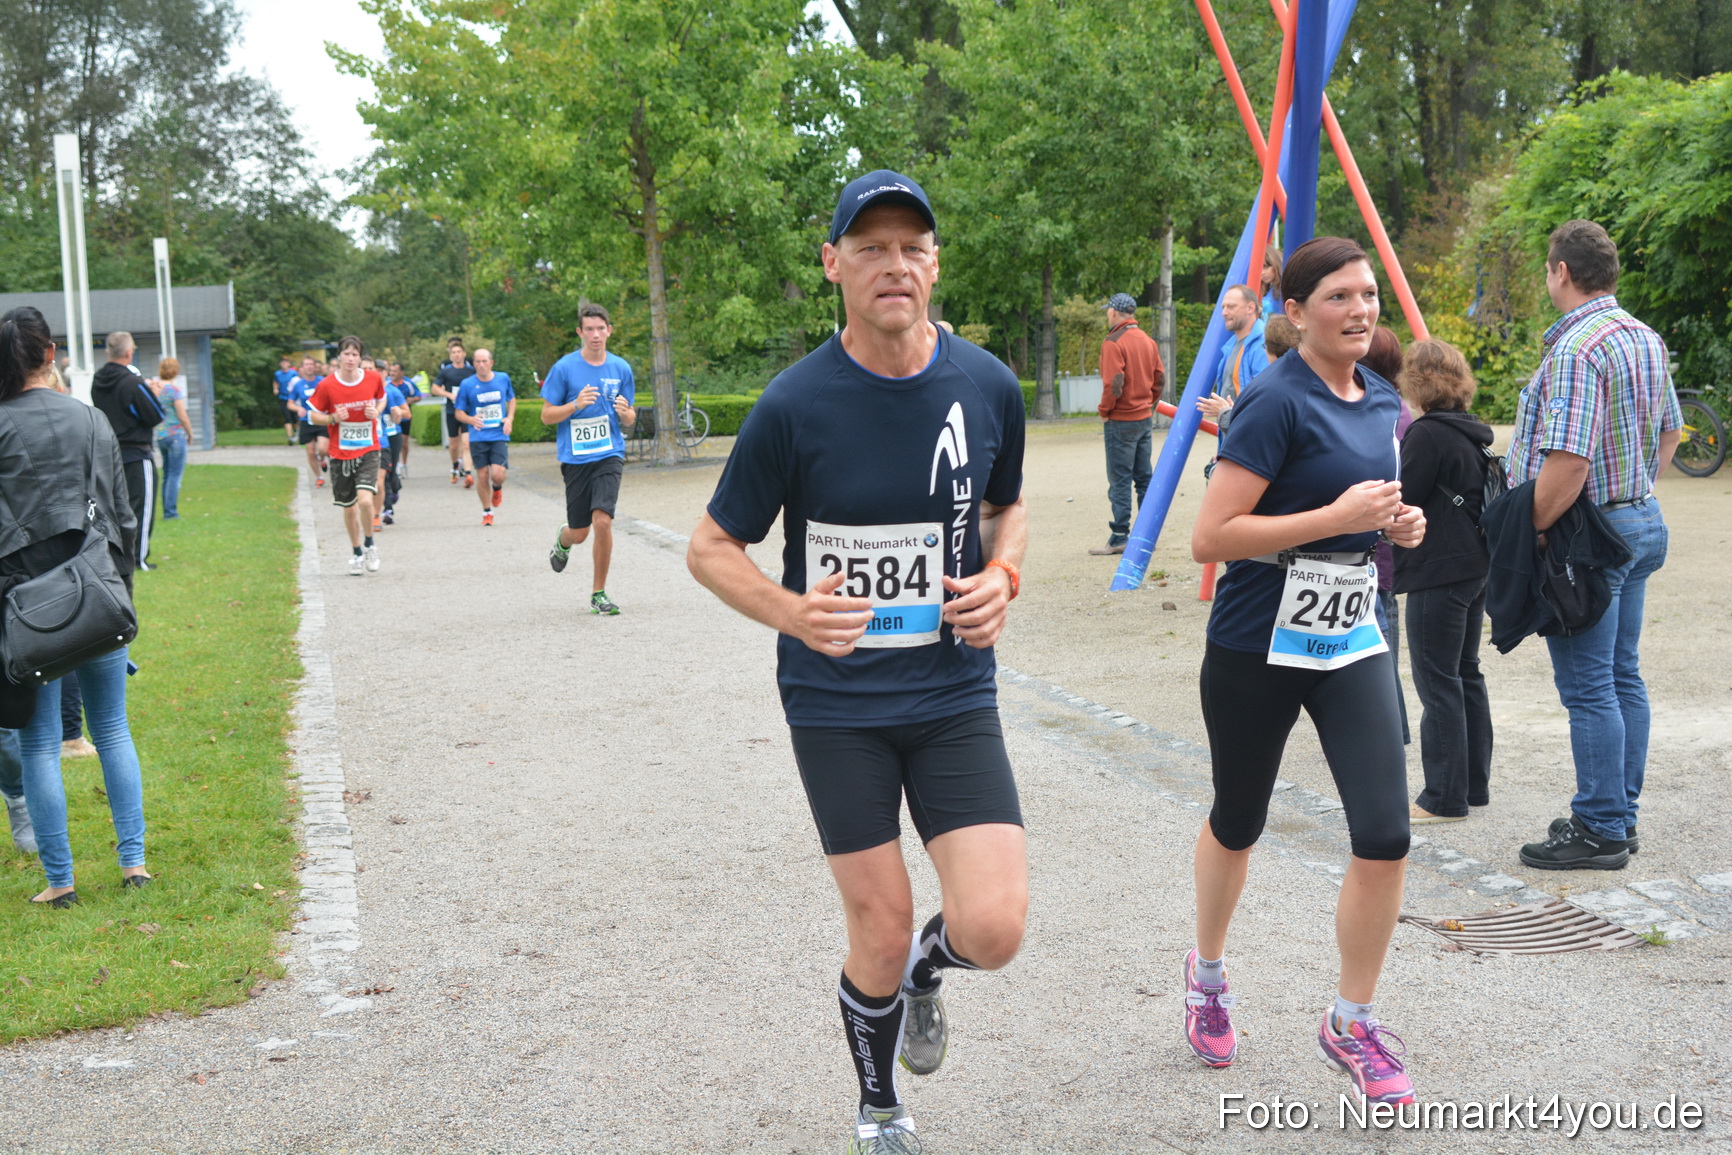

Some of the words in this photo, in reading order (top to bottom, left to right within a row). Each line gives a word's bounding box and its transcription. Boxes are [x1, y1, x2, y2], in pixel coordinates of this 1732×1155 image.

[575, 424, 607, 441] 2670
[808, 533, 850, 549] PARTL
[853, 537, 918, 550] Neumarkt
[820, 553, 930, 601] 2584
[1289, 569, 1331, 586] PARTL
